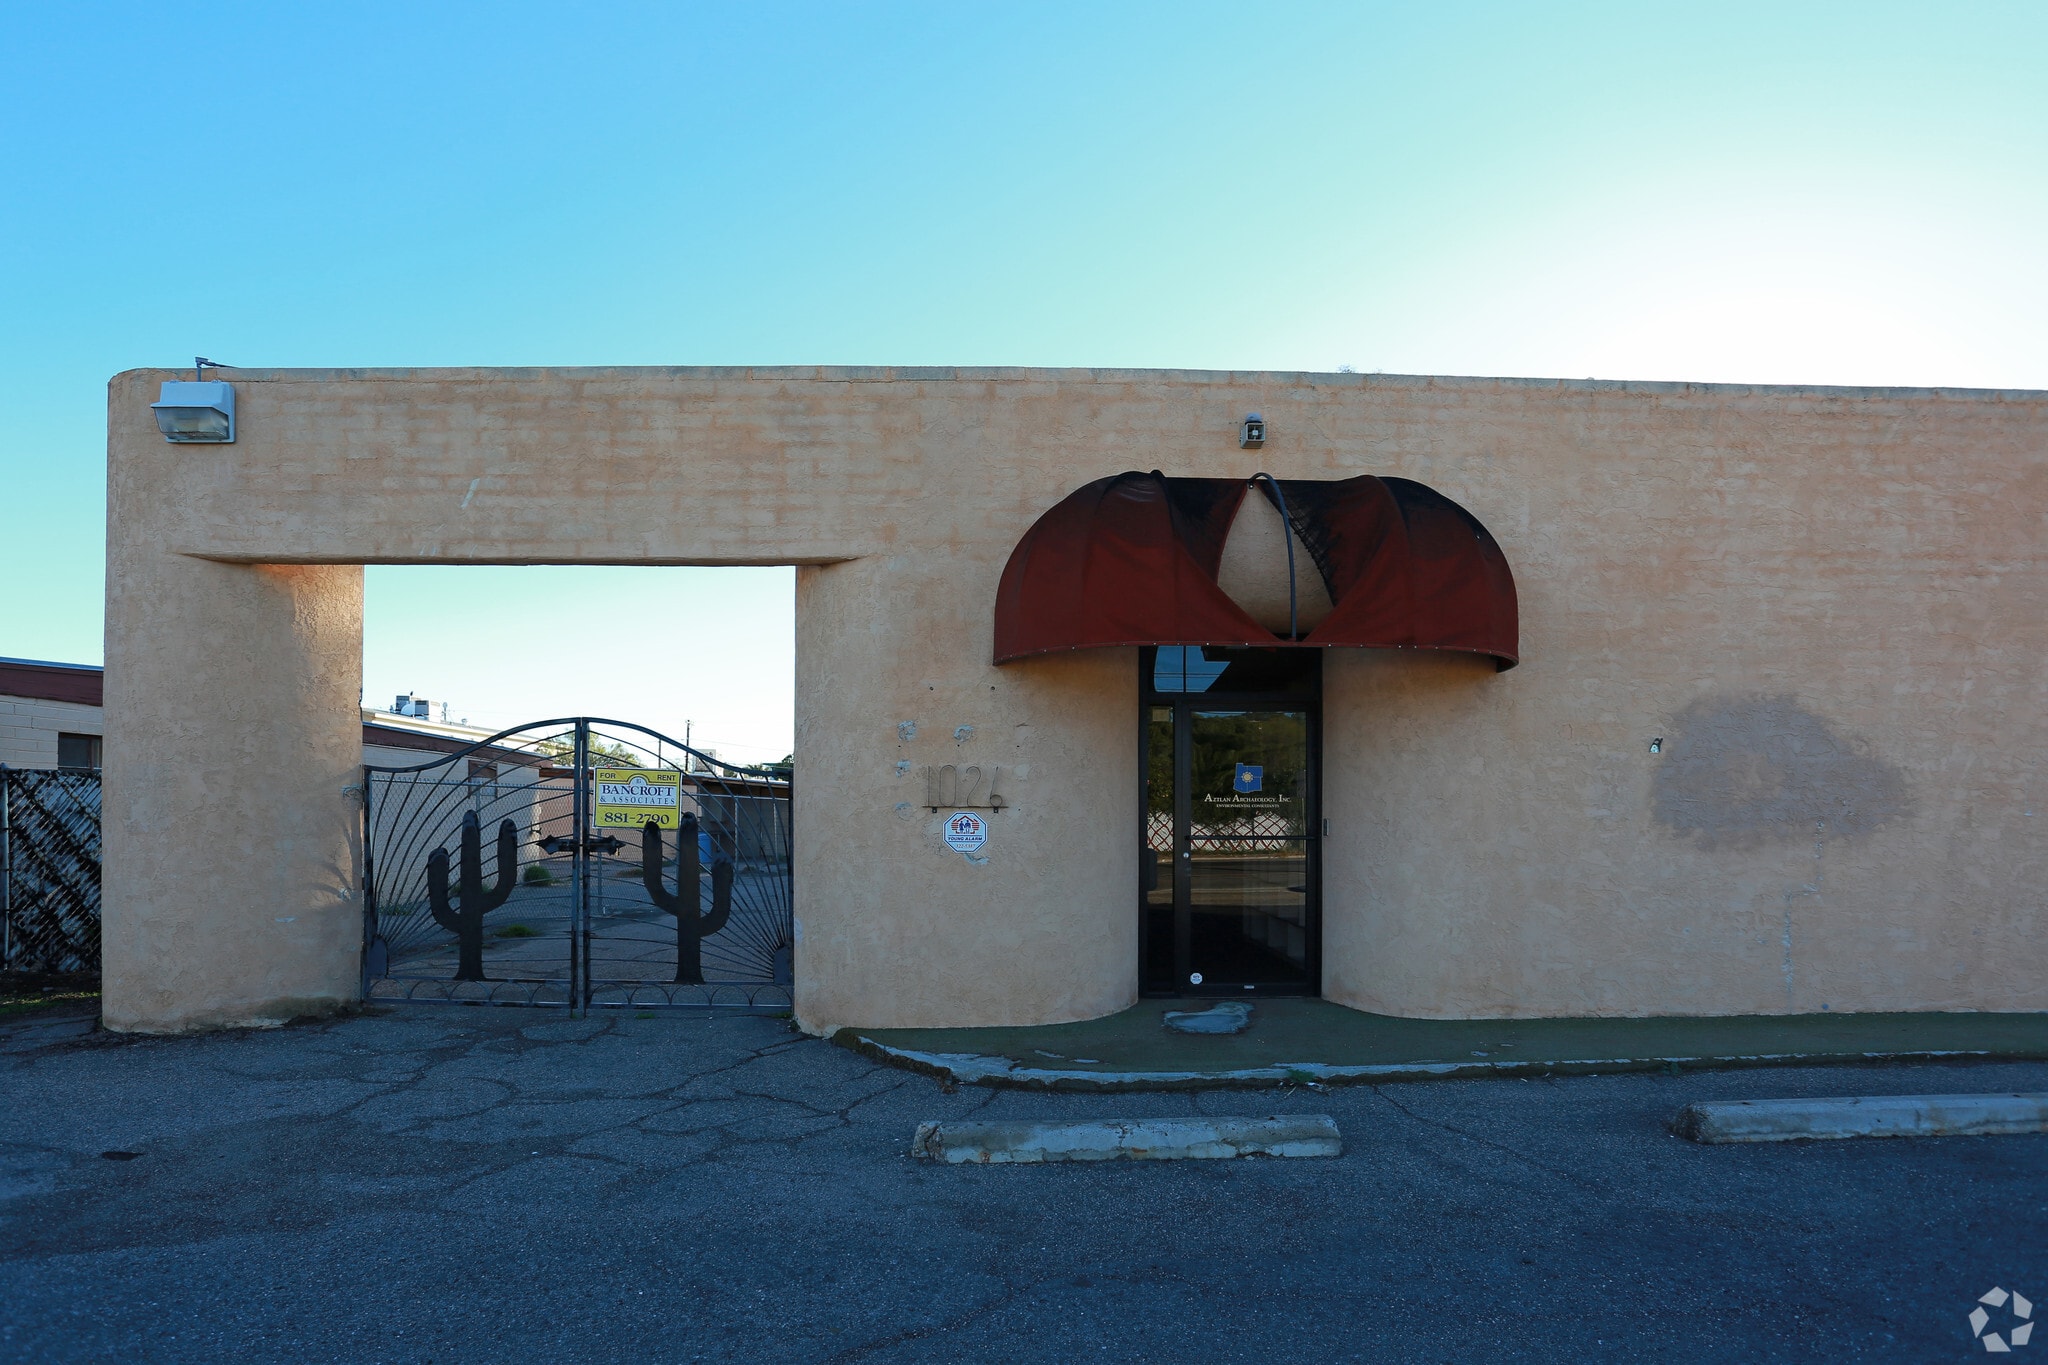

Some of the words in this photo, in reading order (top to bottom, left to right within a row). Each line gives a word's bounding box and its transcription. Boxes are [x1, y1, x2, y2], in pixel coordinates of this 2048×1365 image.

[602, 784, 674, 797] BANCROFT
[600, 795, 607, 803] &
[611, 796, 675, 805] ASSOCIATES
[604, 812, 670, 825] 881-2790
